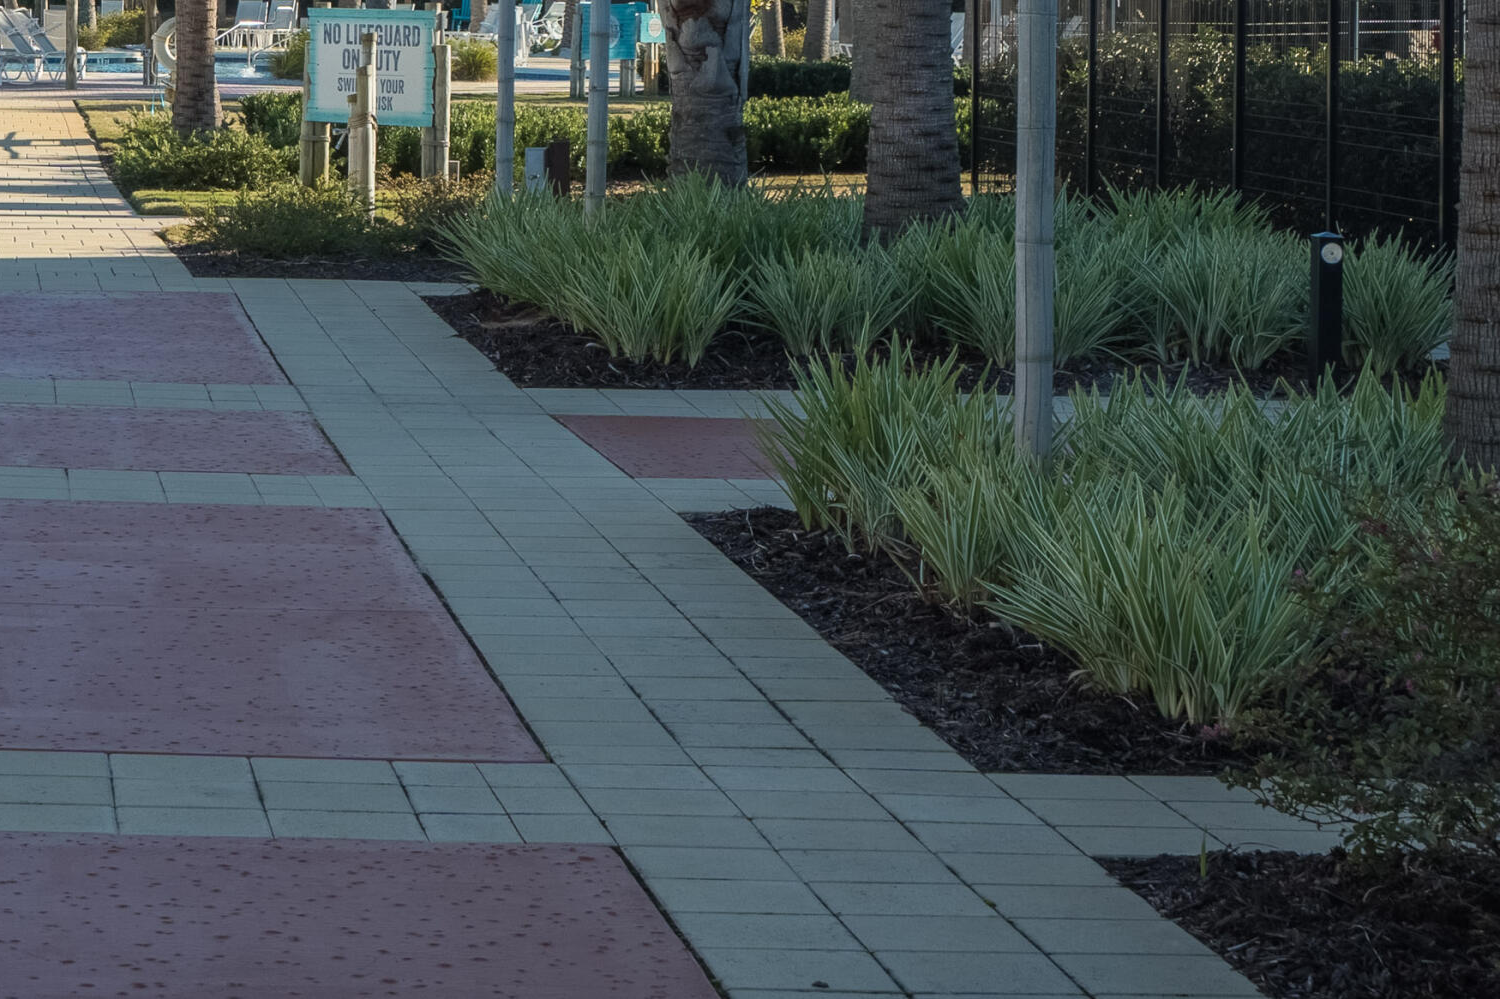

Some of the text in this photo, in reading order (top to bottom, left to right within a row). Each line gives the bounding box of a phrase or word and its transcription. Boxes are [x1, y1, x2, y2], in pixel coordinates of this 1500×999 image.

[324, 23, 341, 44] NO
[342, 48, 401, 71] ON UTY
[337, 77, 404, 94] SWI YOUR
[376, 96, 393, 111] ISK
